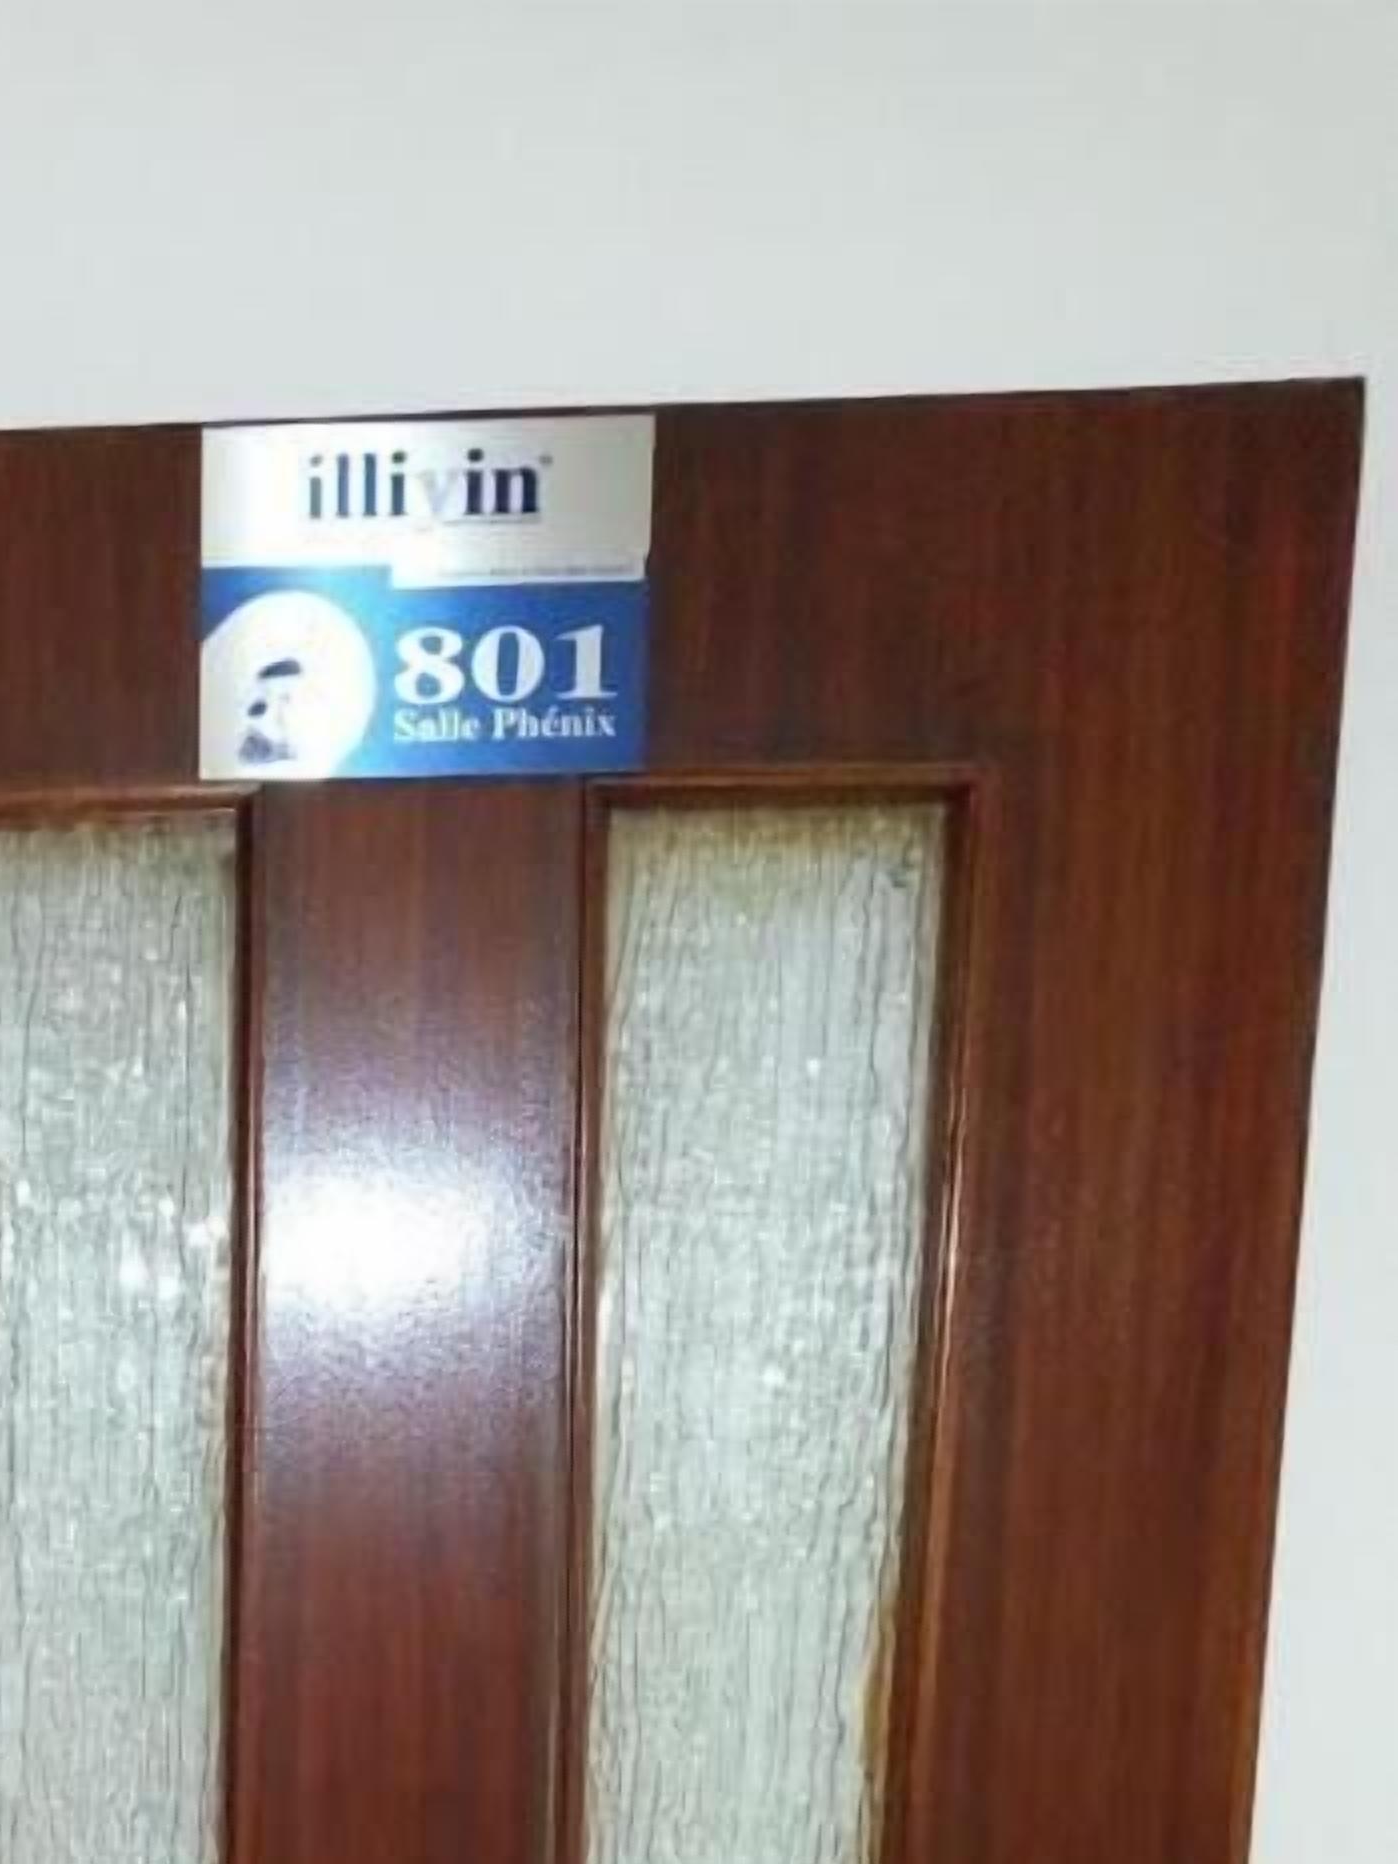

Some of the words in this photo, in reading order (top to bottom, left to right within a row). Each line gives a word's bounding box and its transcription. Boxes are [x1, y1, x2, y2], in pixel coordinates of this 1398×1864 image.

[394, 624, 618, 705] 801
[394, 708, 481, 742] Salle
[492, 705, 616, 740] Phénix
